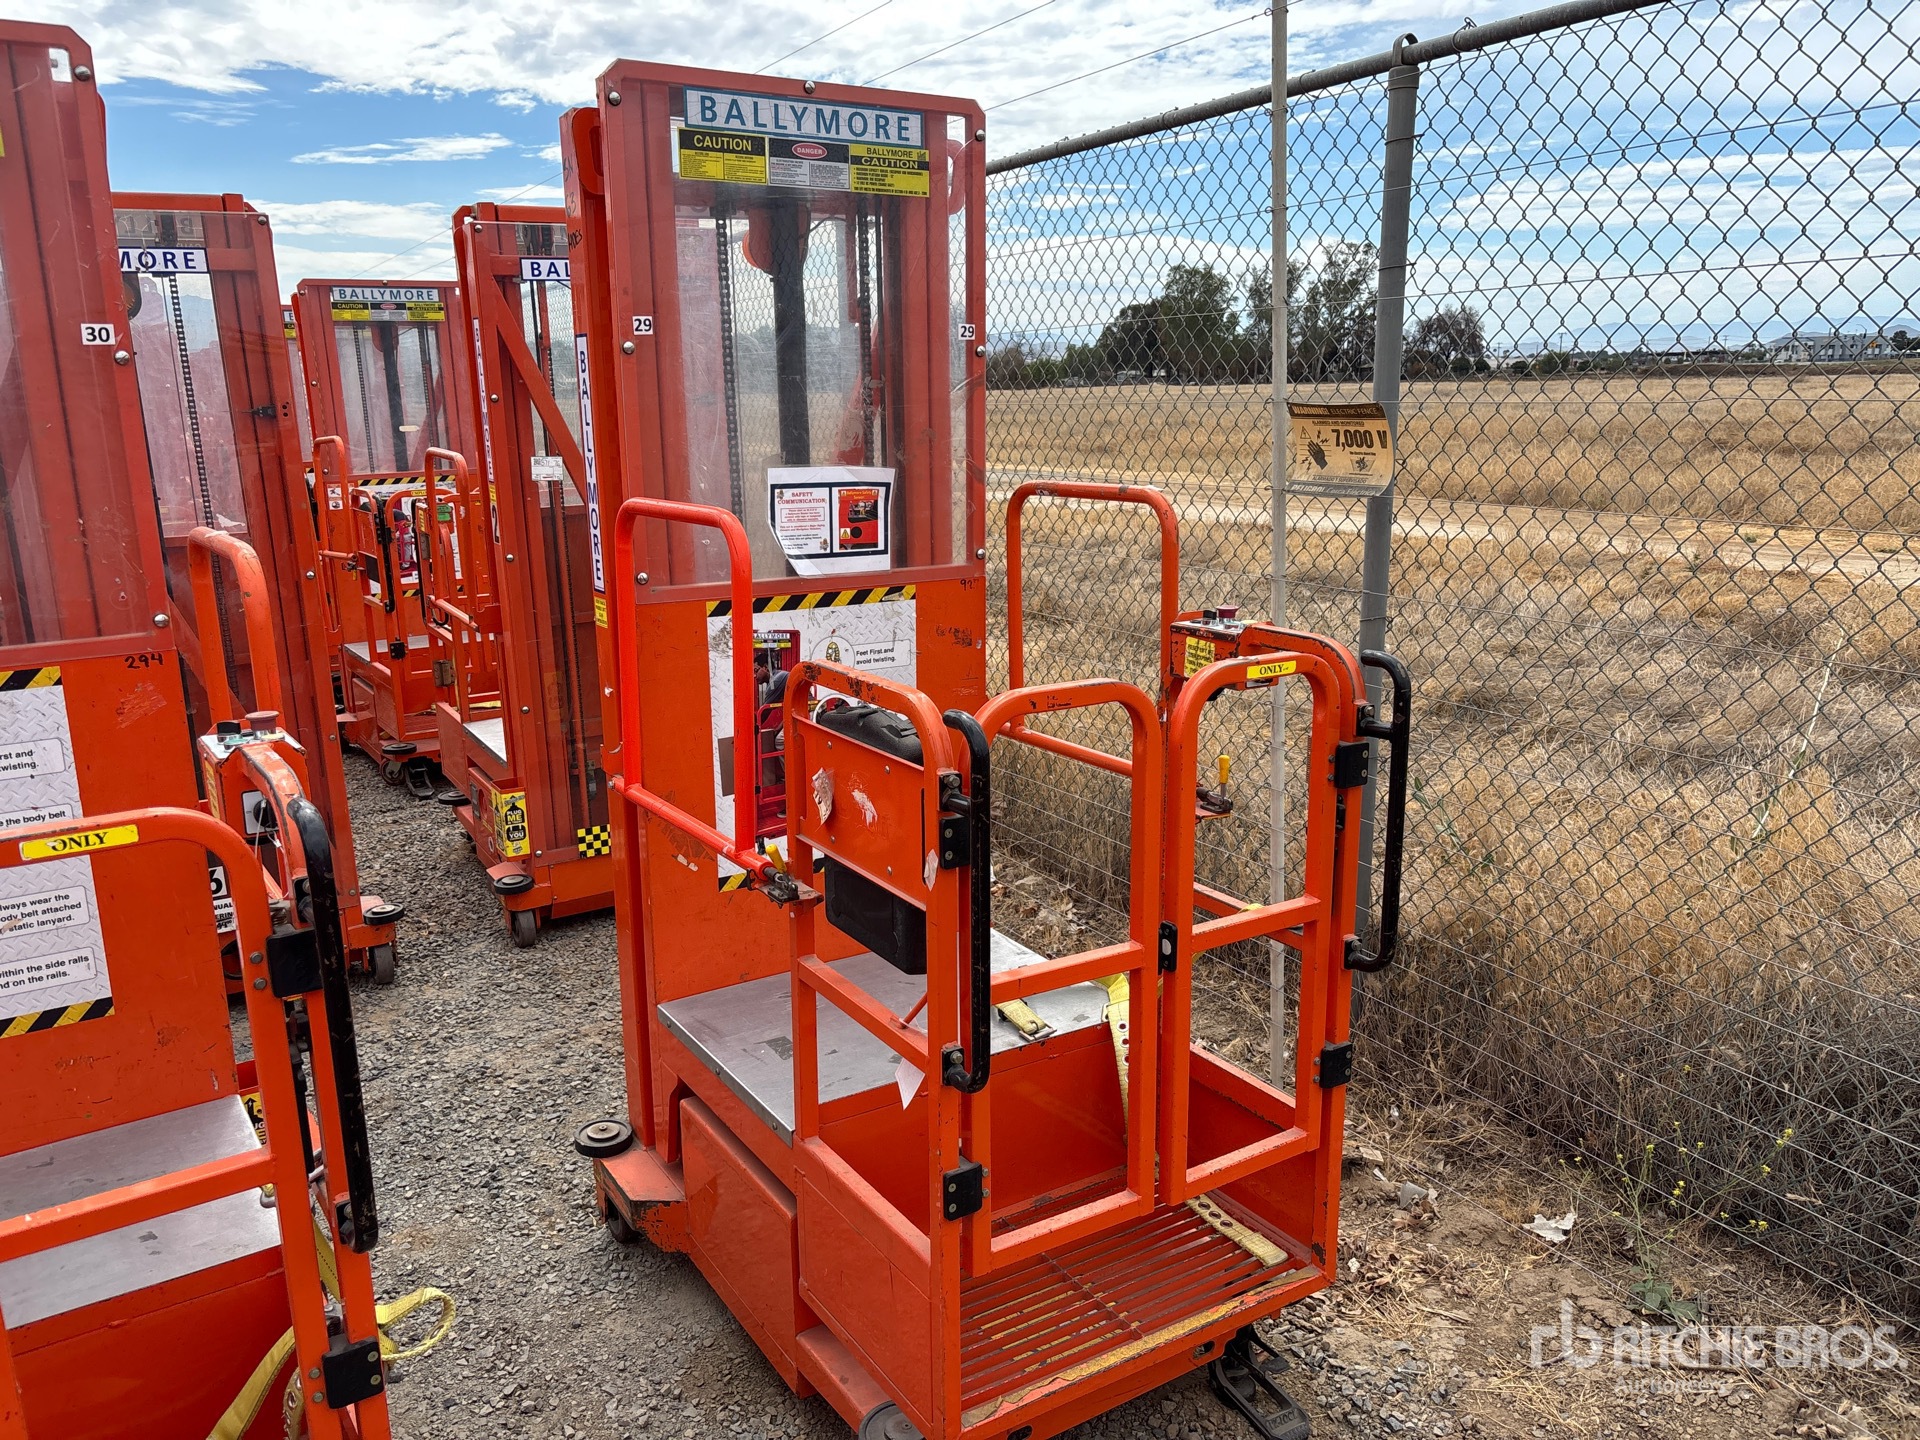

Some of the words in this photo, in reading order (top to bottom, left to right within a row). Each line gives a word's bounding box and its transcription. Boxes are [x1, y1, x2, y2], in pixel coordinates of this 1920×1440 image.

[700, 95, 910, 142] BALLYMORE
[693, 134, 752, 152] CAUTION
[797, 147, 823, 155] DANGER
[866, 147, 914, 159] BALLYMORE
[861, 157, 918, 169] CAUTION
[338, 288, 434, 301] BALLYMORE
[634, 318, 652, 332] 29
[960, 325, 975, 338] 29
[85, 326, 110, 343] 30
[1292, 405, 1330, 415] WARNING!
[1330, 407, 1357, 415] ELECTRIC
[1358, 407, 1378, 415] FENCE
[1331, 429, 1374, 452] 7,000
[1376, 429, 1388, 449] V
[579, 350, 602, 581] BALLYMORE
[125, 653, 164, 669] 294
[1260, 664, 1284, 675] ONLY
[15, 749, 33, 758] and
[6, 818, 21, 826] the
[23, 814, 46, 823] body
[48, 811, 66, 819] belt
[507, 814, 523, 822] ME
[51, 831, 108, 852] ONLY
[509, 831, 524, 839] YOU
[29, 896, 52, 906] wear
[54, 893, 70, 902] the
[20, 911, 39, 919] belt
[41, 901, 82, 915] attached
[9, 922, 34, 932] static
[36, 914, 75, 926] lanyard.
[26, 965, 43, 974] the
[45, 960, 66, 970] side
[68, 955, 90, 965] rails
[12, 978, 26, 987] on
[27, 976, 44, 984] the
[46, 970, 70, 980] rails.
